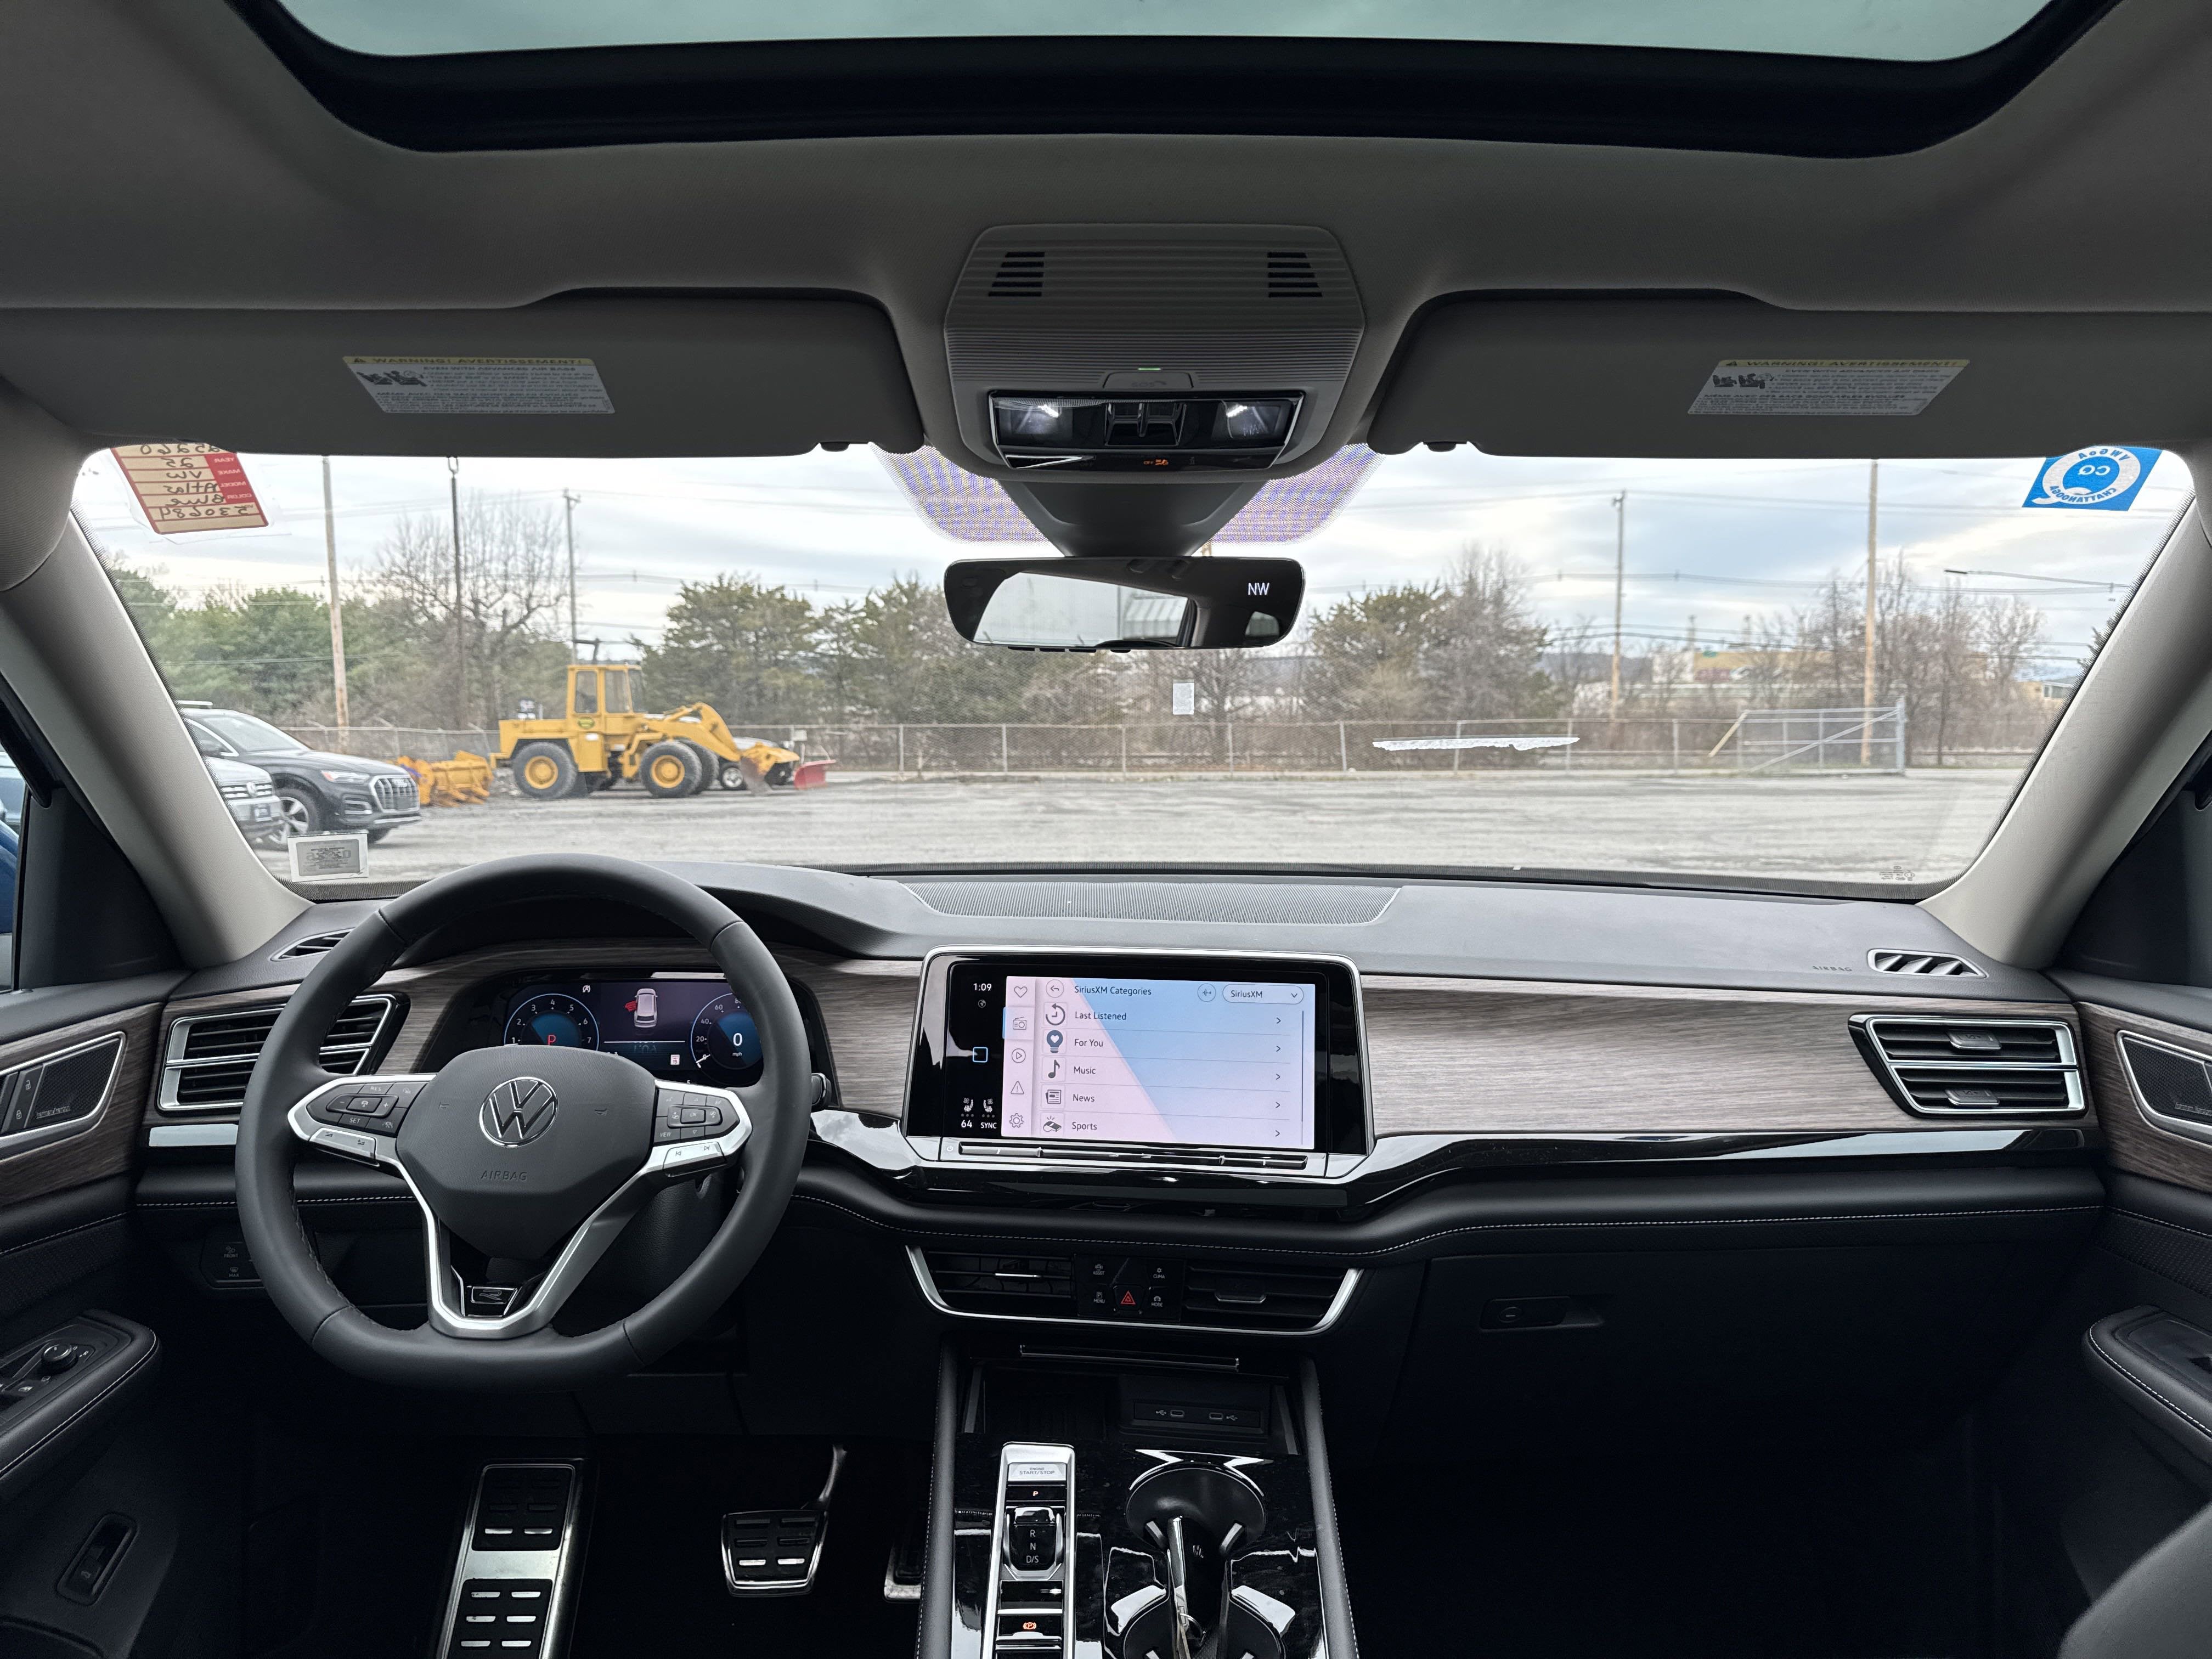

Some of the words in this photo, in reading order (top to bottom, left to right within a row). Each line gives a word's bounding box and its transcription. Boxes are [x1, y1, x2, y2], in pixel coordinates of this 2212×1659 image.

[1248, 583, 1270, 596] NW
[973, 983, 992, 991] 1:09
[1074, 986, 1108, 994] SiriusXM
[1110, 986, 1152, 997] Categories
[1231, 990, 1263, 998] SiriusXM
[1075, 1011, 1091, 1020] Last
[1093, 1012, 1127, 1020] Listened
[548, 1034, 556, 1046] P
[733, 1032, 743, 1046] 0
[1074, 1039, 1087, 1047] For
[1089, 1039, 1104, 1048] You
[1073, 1066, 1096, 1075] Music
[1073, 1094, 1095, 1103] News
[961, 1120, 973, 1128] 64
[1071, 1121, 1097, 1131] Sports
[481, 1170, 528, 1181] AIRBAG
[1030, 1529, 1036, 1537] R
[1030, 1542, 1036, 1550] N
[1026, 1555, 1039, 1564] D/S
